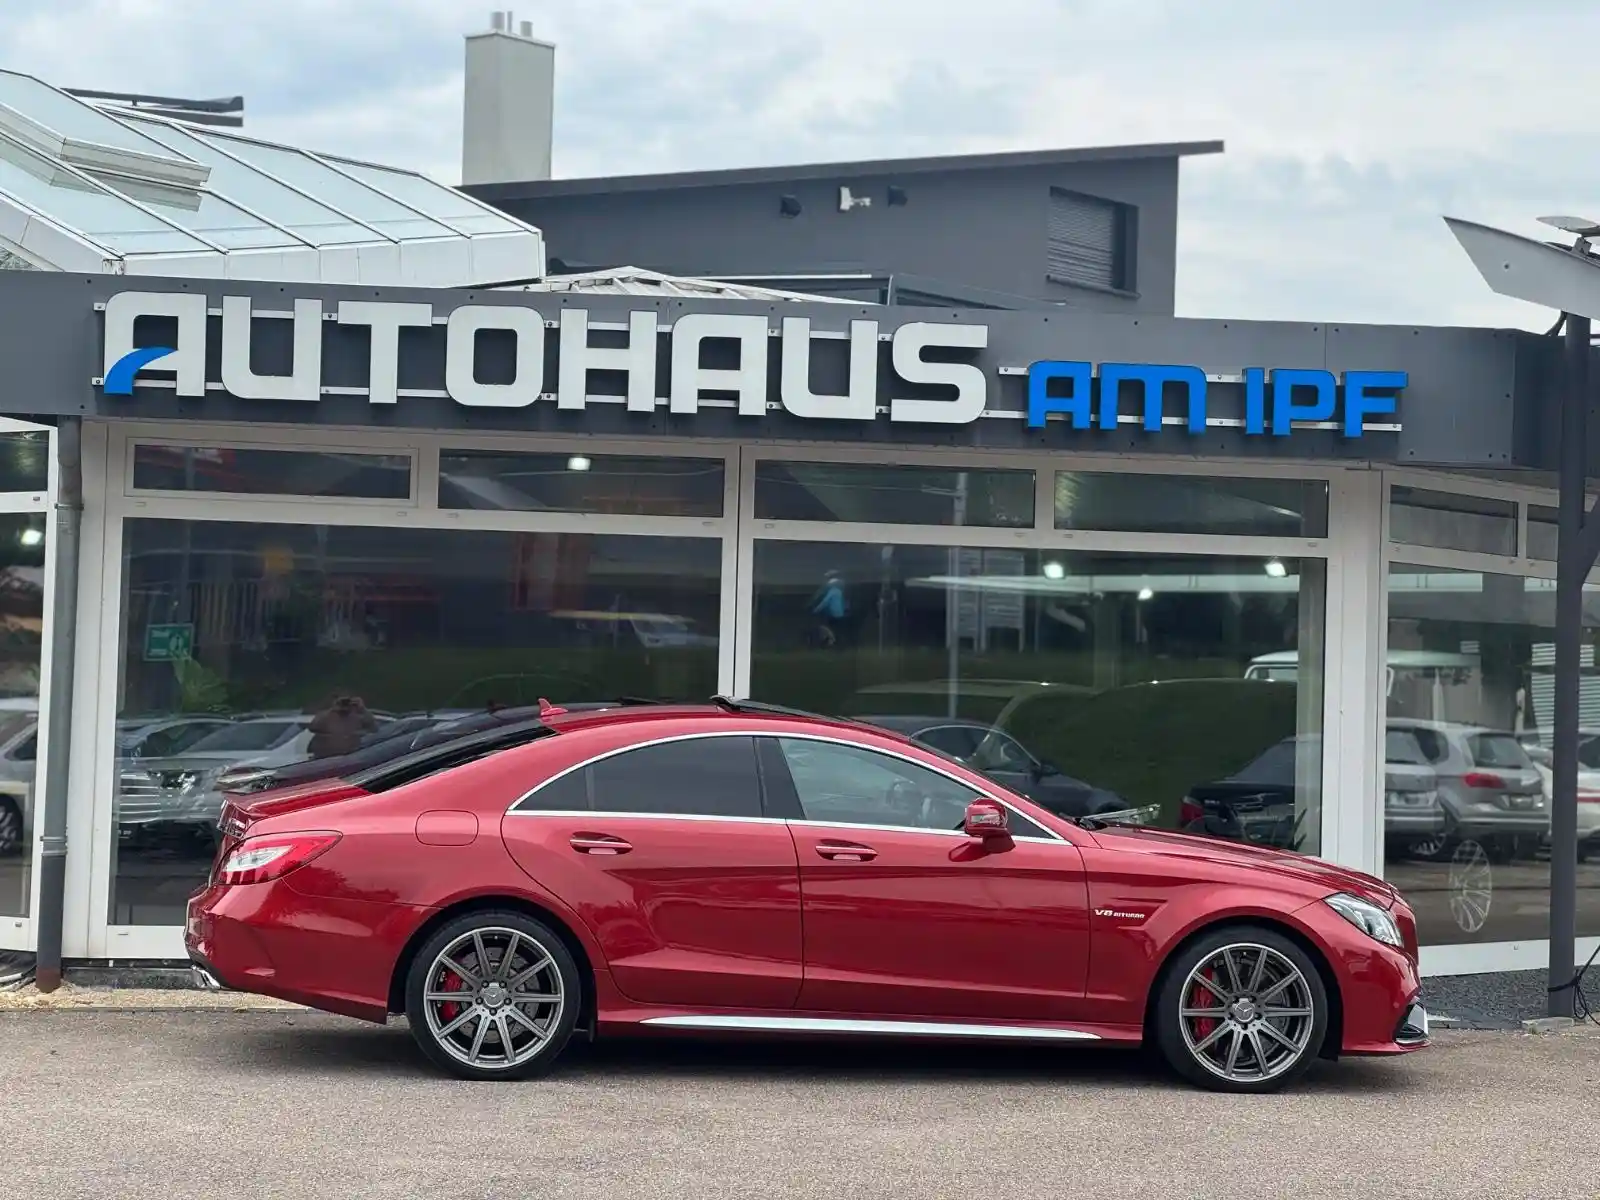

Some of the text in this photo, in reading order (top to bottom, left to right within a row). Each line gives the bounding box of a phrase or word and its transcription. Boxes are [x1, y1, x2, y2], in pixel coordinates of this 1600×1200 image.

[104, 290, 1408, 437] AUTOHAUS AM IPF
[1094, 909, 1113, 917] V8
